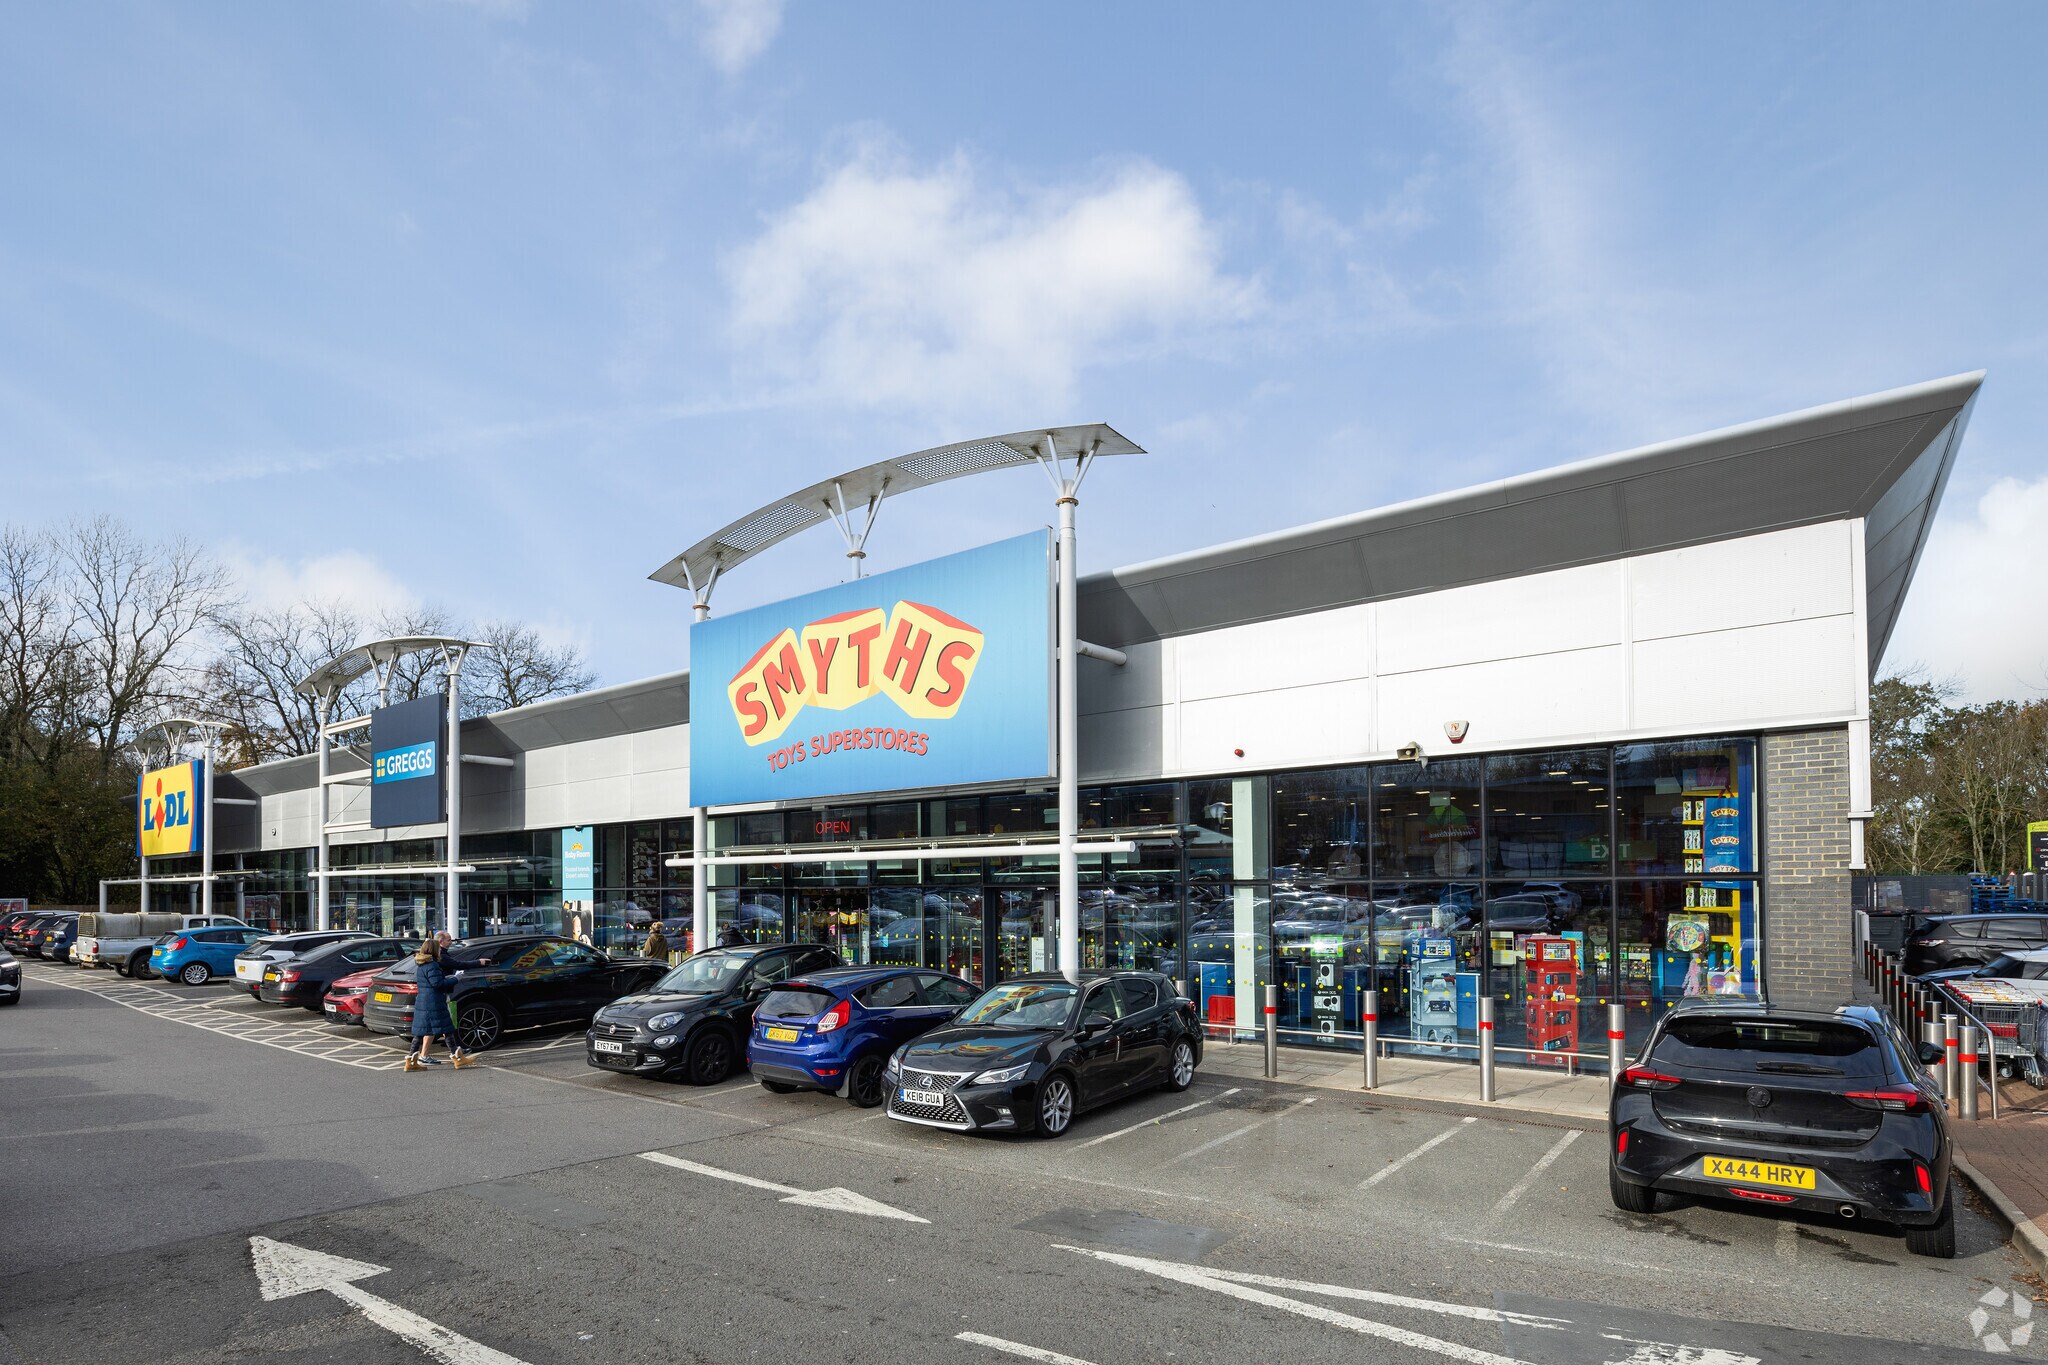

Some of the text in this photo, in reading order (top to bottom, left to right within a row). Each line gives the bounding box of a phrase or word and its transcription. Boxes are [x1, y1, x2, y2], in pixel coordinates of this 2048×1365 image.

[735, 618, 976, 737] SMYTHS
[386, 748, 432, 775] GREGGS
[767, 727, 930, 773] TOYS SUPERSTORES
[815, 820, 850, 835] OPEN
[1591, 843, 1631, 859] EXT
[906, 1091, 941, 1105] KE18 GUA
[1711, 1159, 1806, 1185] X444 HRY
